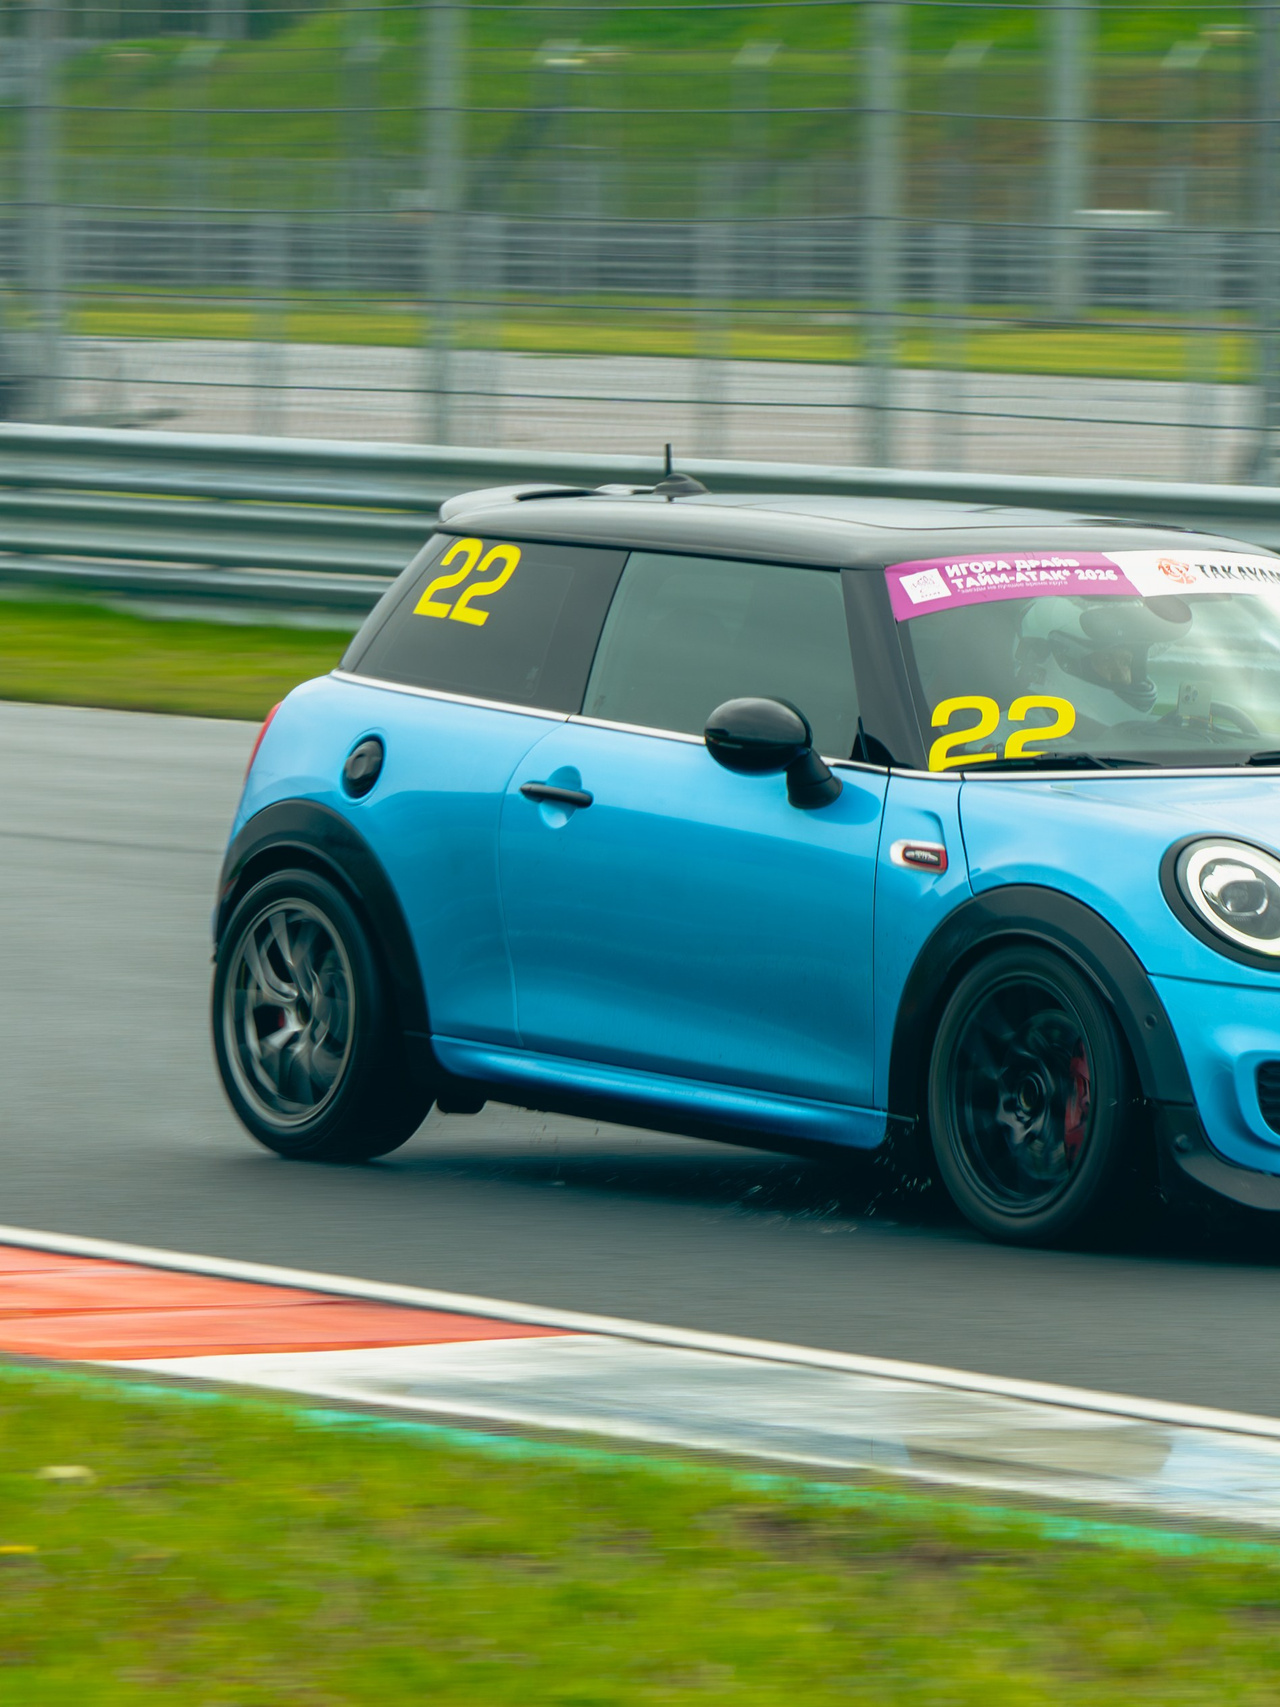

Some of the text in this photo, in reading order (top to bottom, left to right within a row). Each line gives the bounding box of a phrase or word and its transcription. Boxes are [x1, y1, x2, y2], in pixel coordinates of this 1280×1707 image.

[412, 537, 521, 627] 22
[944, 560, 1011, 579] ИГОРА
[1074, 569, 1118, 581] 2026
[928, 695, 1076, 772] 22
